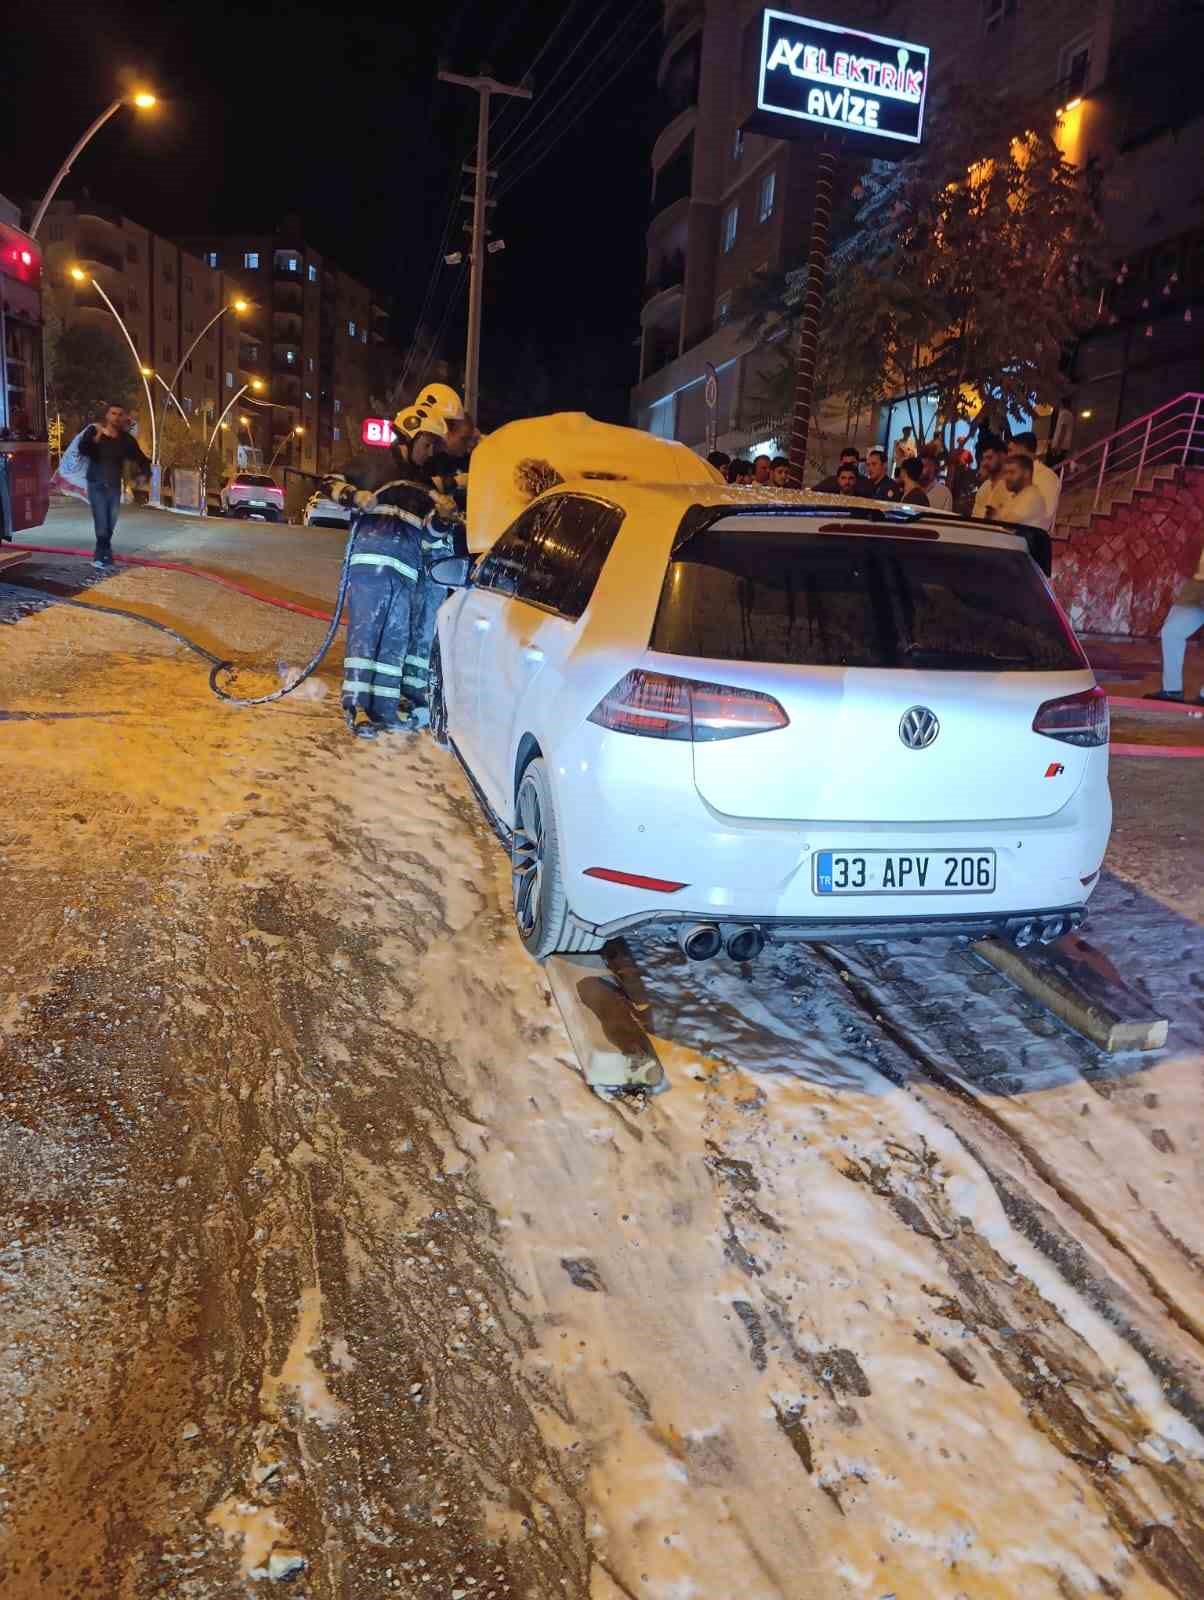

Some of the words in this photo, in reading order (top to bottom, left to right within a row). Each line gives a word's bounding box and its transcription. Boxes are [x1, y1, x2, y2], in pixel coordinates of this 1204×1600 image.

[807, 87, 880, 129] AVİZE
[367, 419, 398, 443] Bİ
[819, 876, 832, 886] TR
[834, 857, 867, 888] 33
[882, 857, 929, 888] APV
[944, 857, 990, 887] 206
